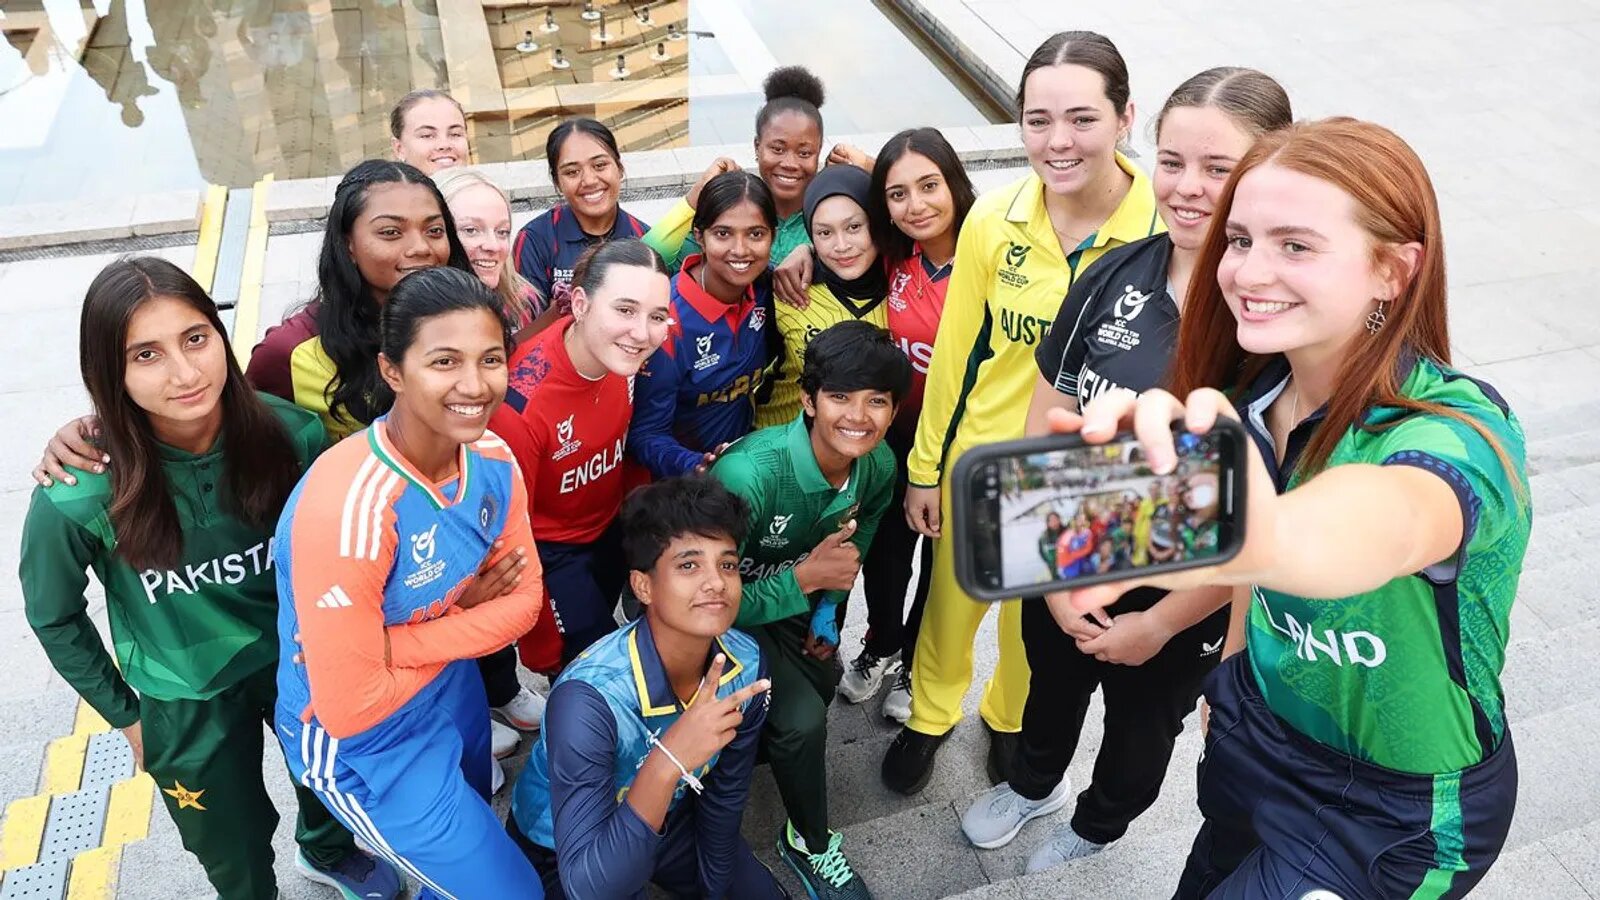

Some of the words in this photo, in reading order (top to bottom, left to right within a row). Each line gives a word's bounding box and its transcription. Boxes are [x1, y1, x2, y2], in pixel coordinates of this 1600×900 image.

[1114, 319, 1127, 328] ICC
[1097, 328, 1121, 340] WORLD
[1121, 335, 1140, 346] CUP
[560, 421, 630, 494] ENGLA
[403, 568, 434, 587] WORLD
[433, 561, 447, 575] CUP
[1252, 584, 1387, 668] LAND
